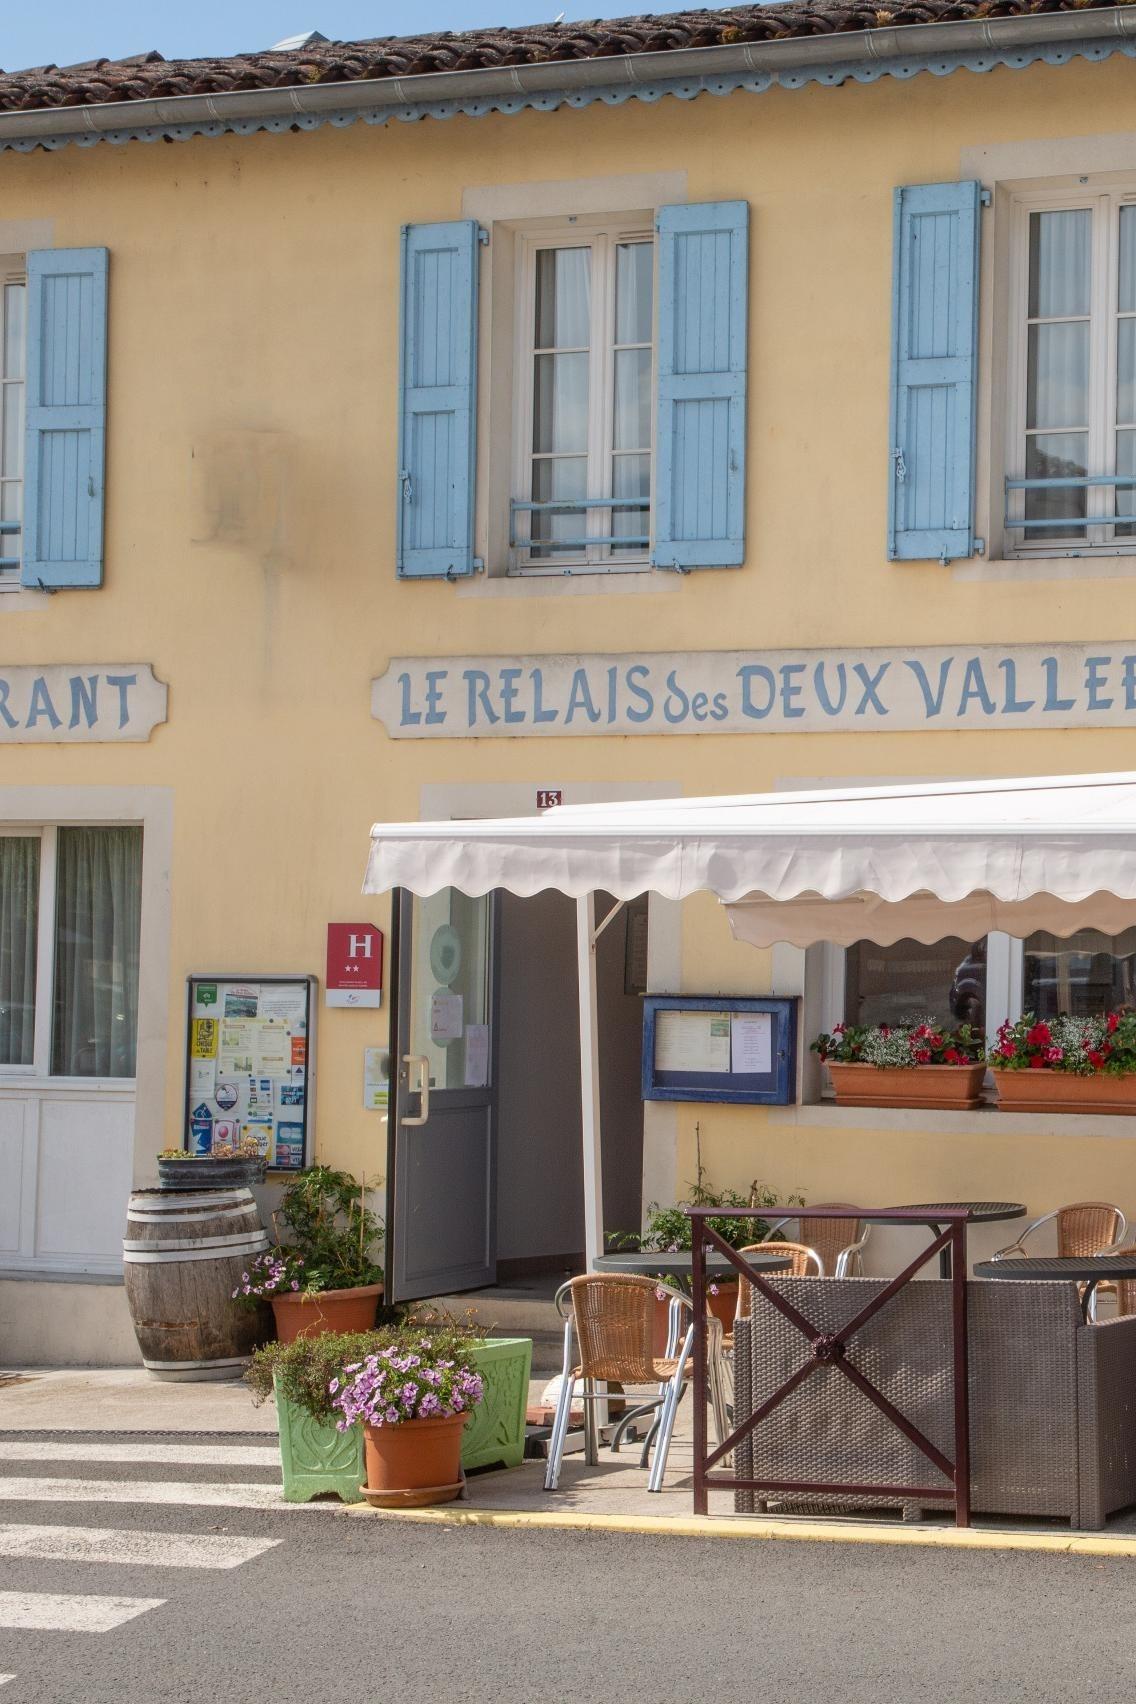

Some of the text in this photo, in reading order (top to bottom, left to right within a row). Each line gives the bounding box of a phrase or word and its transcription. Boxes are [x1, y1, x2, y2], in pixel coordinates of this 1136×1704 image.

[397, 669, 449, 727] LE
[463, 665, 655, 728] RELAIS
[663, 669, 729, 724] des
[736, 660, 892, 719] DEUX
[540, 791, 558, 807] 13
[347, 934, 374, 958] H
